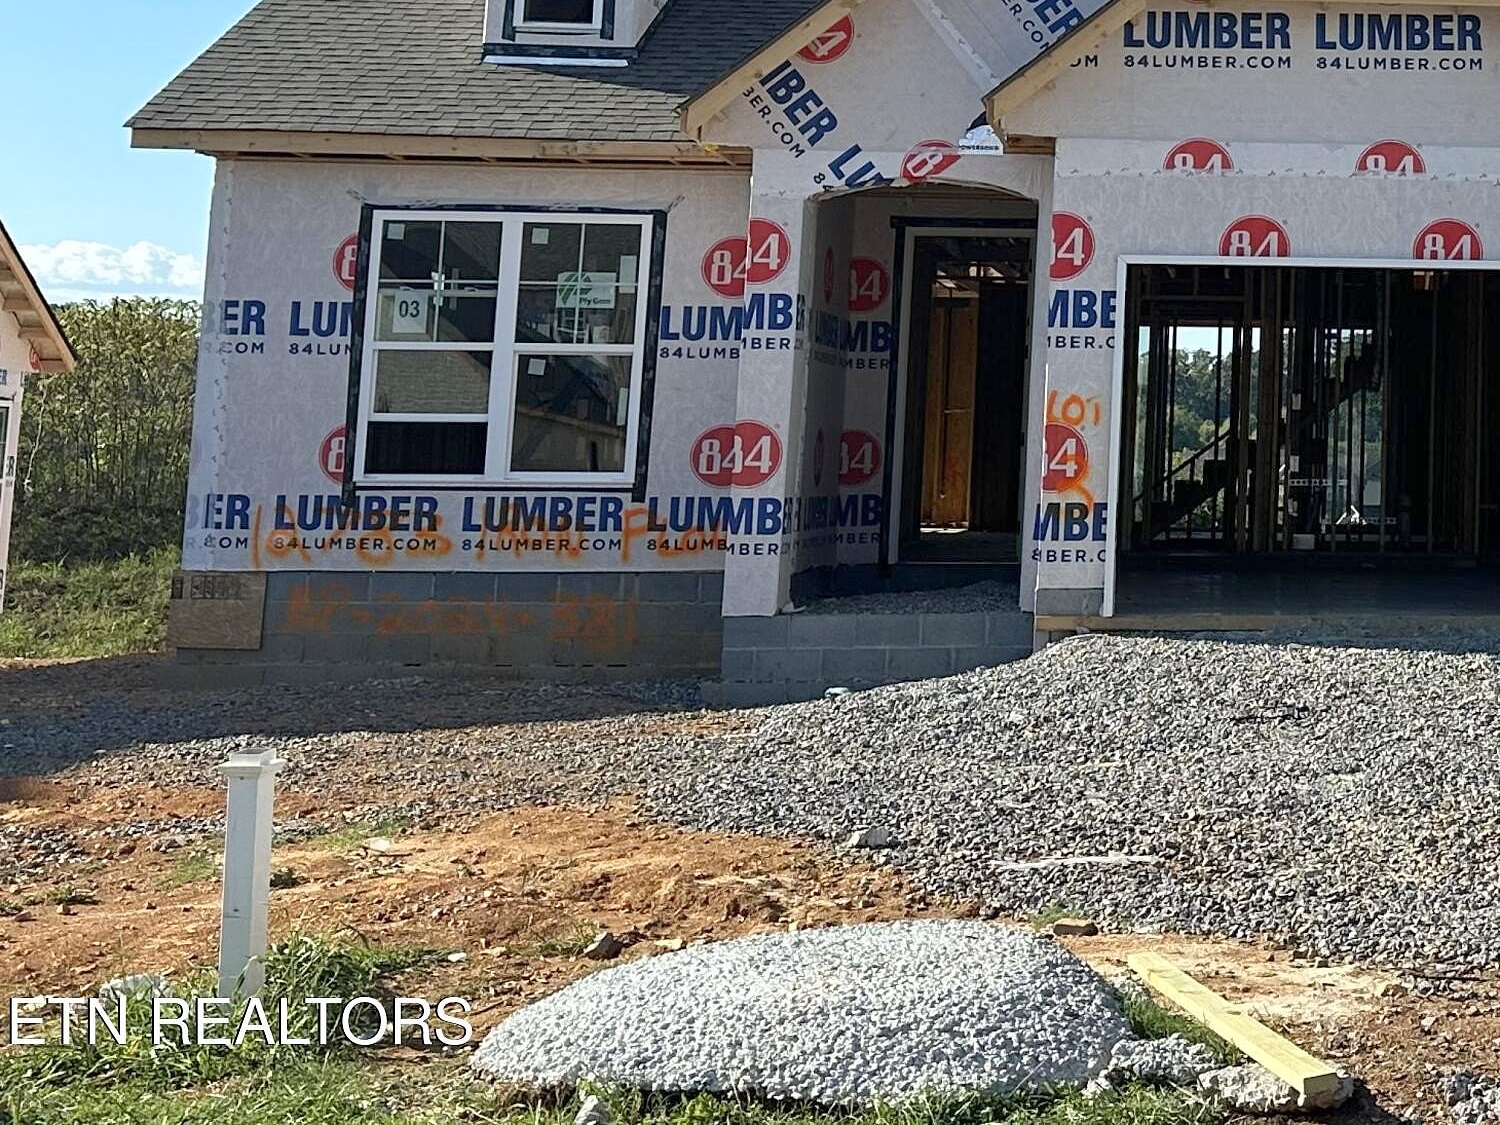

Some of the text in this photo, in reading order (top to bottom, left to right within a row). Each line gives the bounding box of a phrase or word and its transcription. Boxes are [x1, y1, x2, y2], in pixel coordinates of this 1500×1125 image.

[1123, 11, 1291, 50] LUMBER
[1316, 13, 1483, 52] LUMBER
[1124, 55, 1291, 69] 84LUMBER.COM
[1316, 56, 1483, 71] 84LUMBER.COM
[398, 299, 420, 320] 03
[275, 494, 439, 532] LUMBER
[462, 496, 624, 533] LUMBER
[462, 538, 622, 552] 84LUMBER.COM
